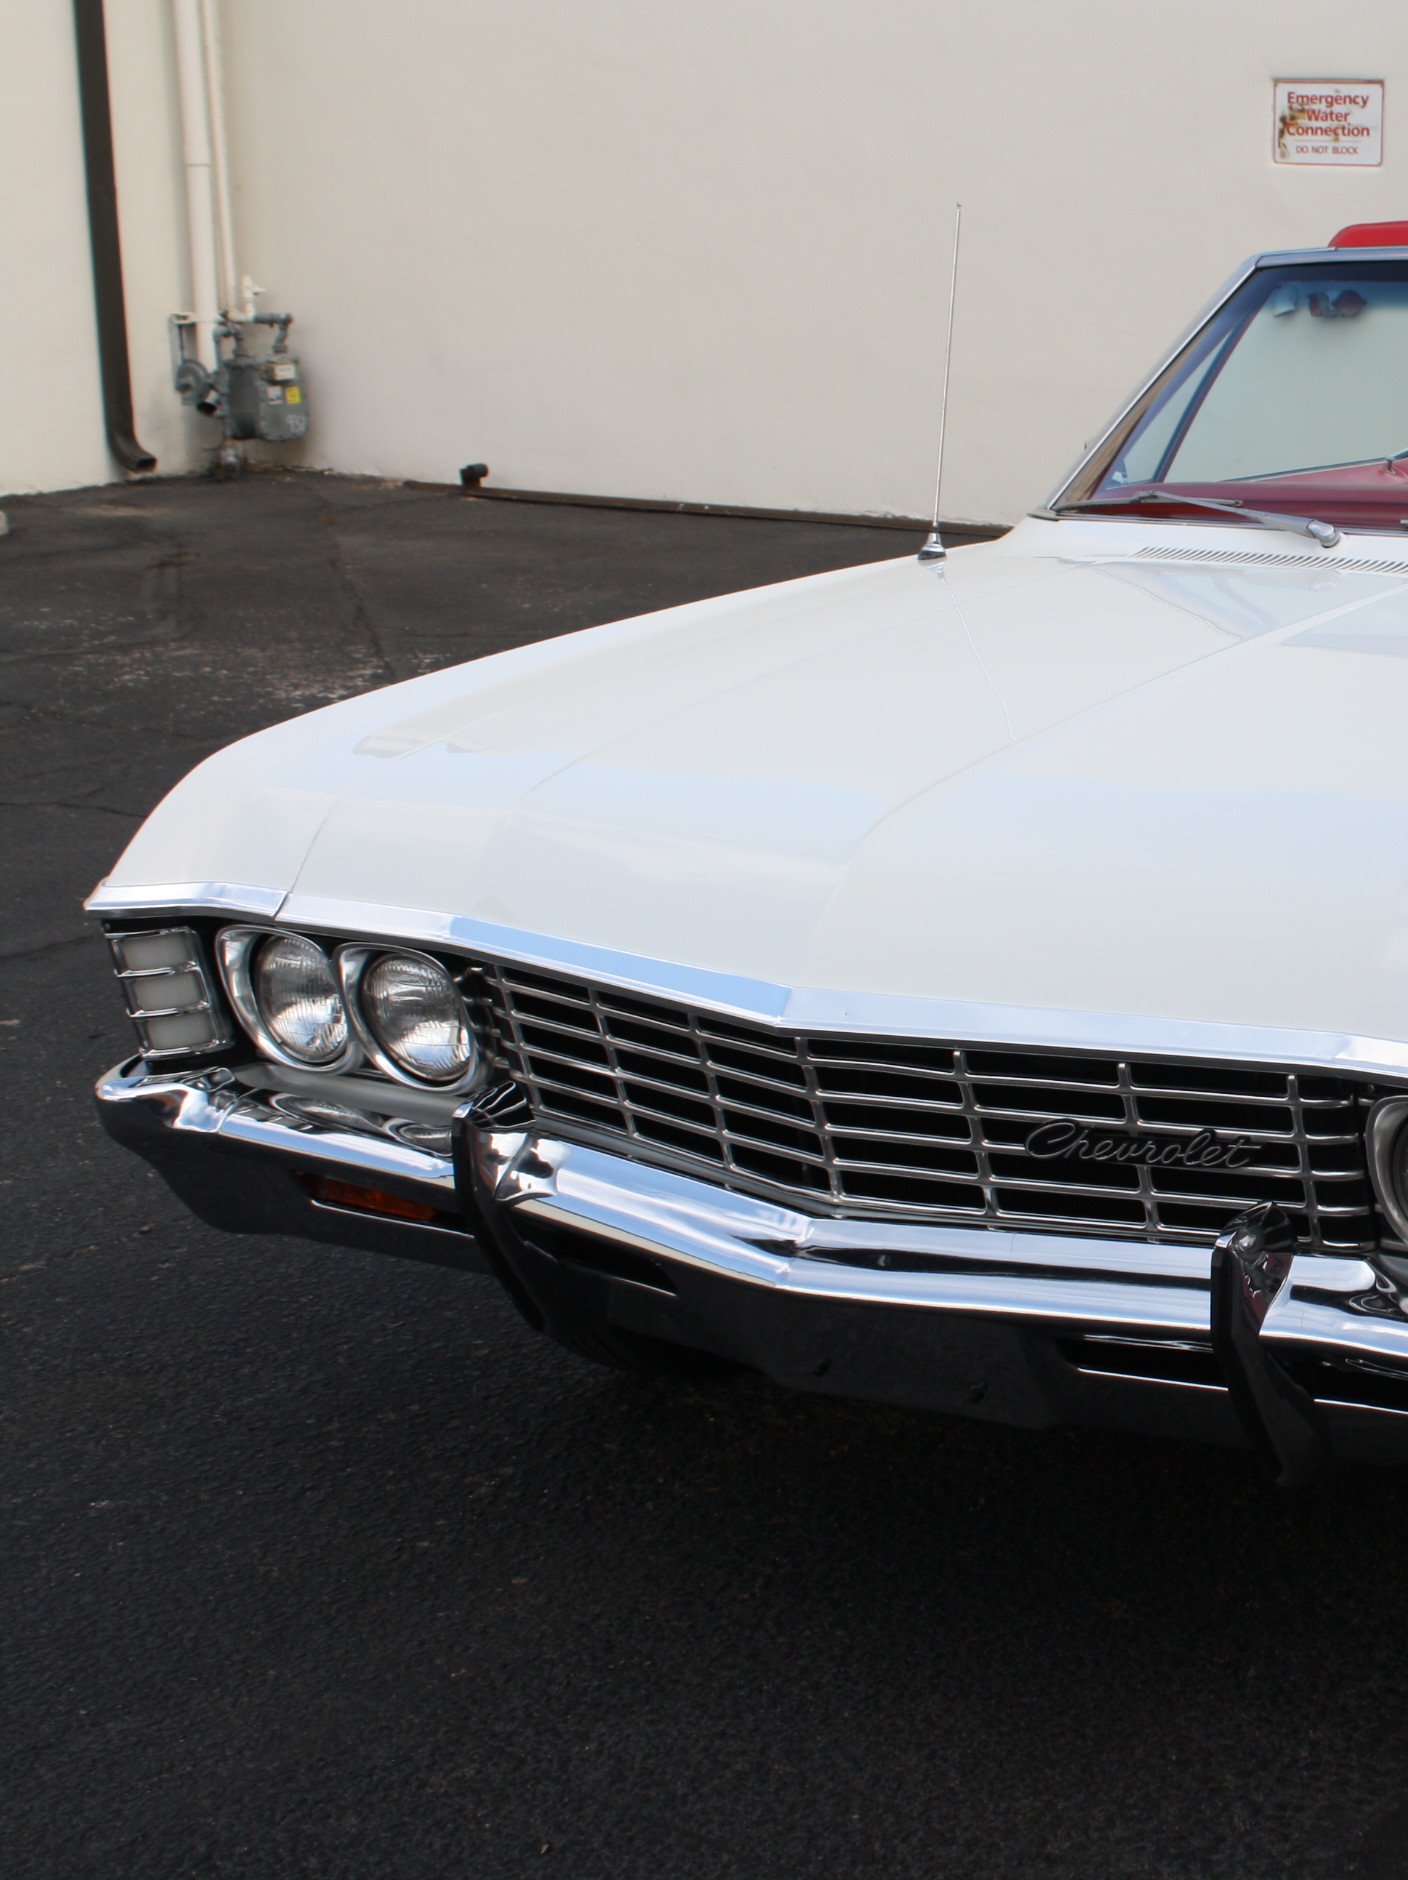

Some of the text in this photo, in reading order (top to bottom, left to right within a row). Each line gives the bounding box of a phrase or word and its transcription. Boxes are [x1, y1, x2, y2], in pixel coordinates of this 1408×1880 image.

[1287, 91, 1370, 109] Emergency
[1306, 108, 1351, 122] Water
[1286, 122, 1370, 137] Connection
[1295, 145, 1359, 155] DO NOT BLOCK
[1026, 1121, 1261, 1168] Chevrolet
